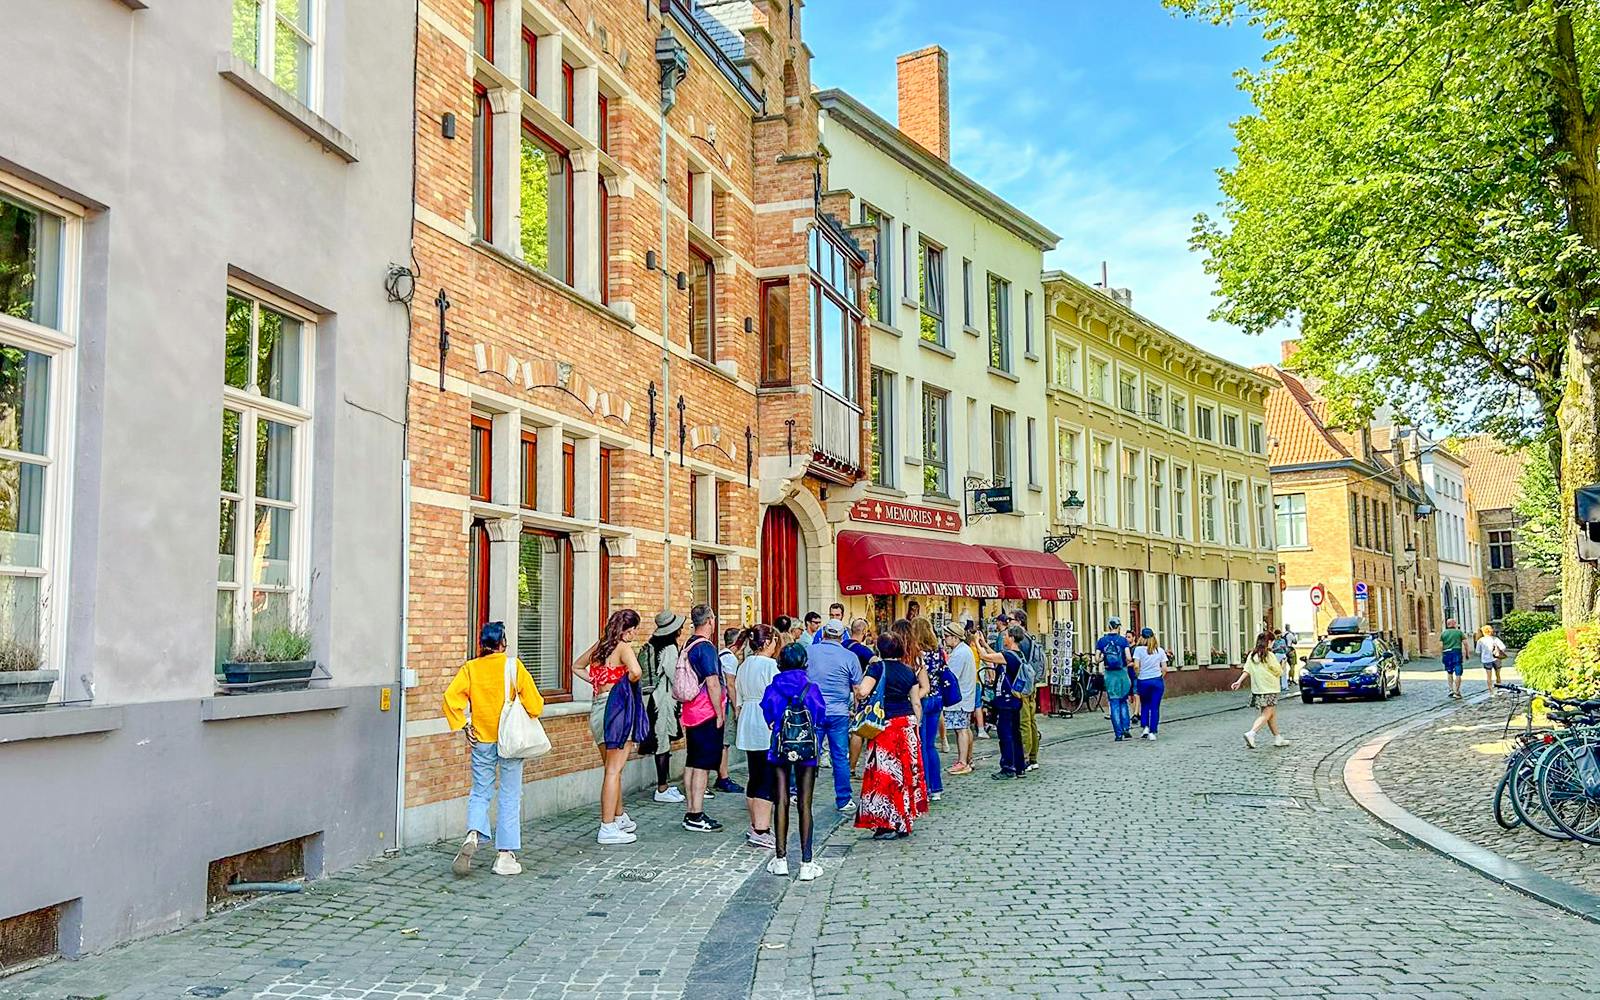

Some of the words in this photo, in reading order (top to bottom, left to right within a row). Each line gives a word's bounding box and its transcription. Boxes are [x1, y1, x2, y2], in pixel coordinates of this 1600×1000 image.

[885, 505, 932, 525] MEMORIES
[899, 580, 931, 595] BELGIAN
[931, 582, 963, 597] TAPESTRY
[1026, 587, 1042, 599] LACE
[1056, 589, 1073, 600] GIFTS
